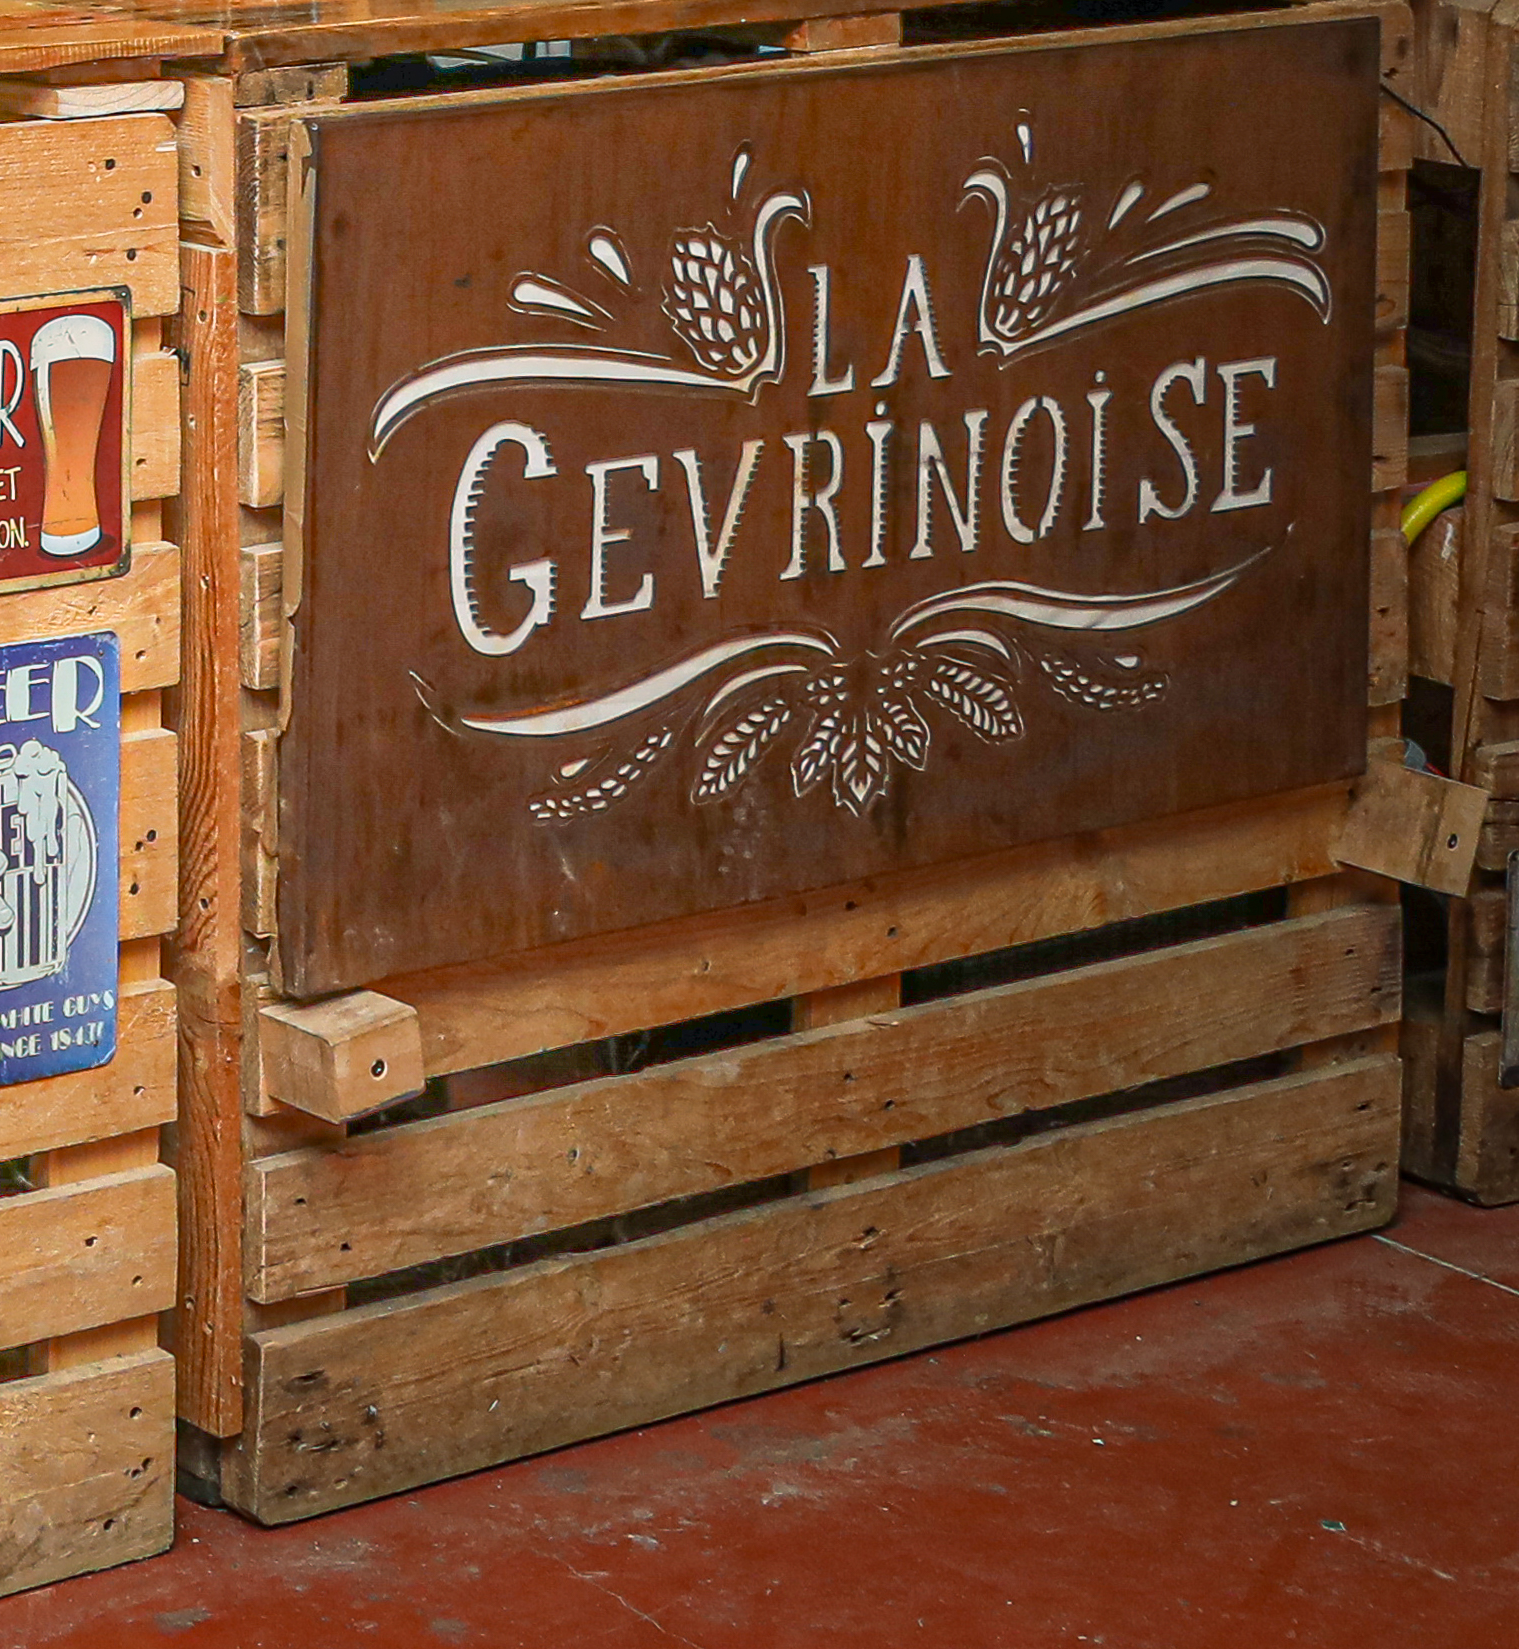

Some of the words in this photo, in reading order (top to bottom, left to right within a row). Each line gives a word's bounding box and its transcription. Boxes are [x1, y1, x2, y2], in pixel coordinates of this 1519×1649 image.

[807, 253, 952, 398] LA
[448, 355, 1278, 656] GEVRINOISE
[62, 990, 115, 1018] GUYS
